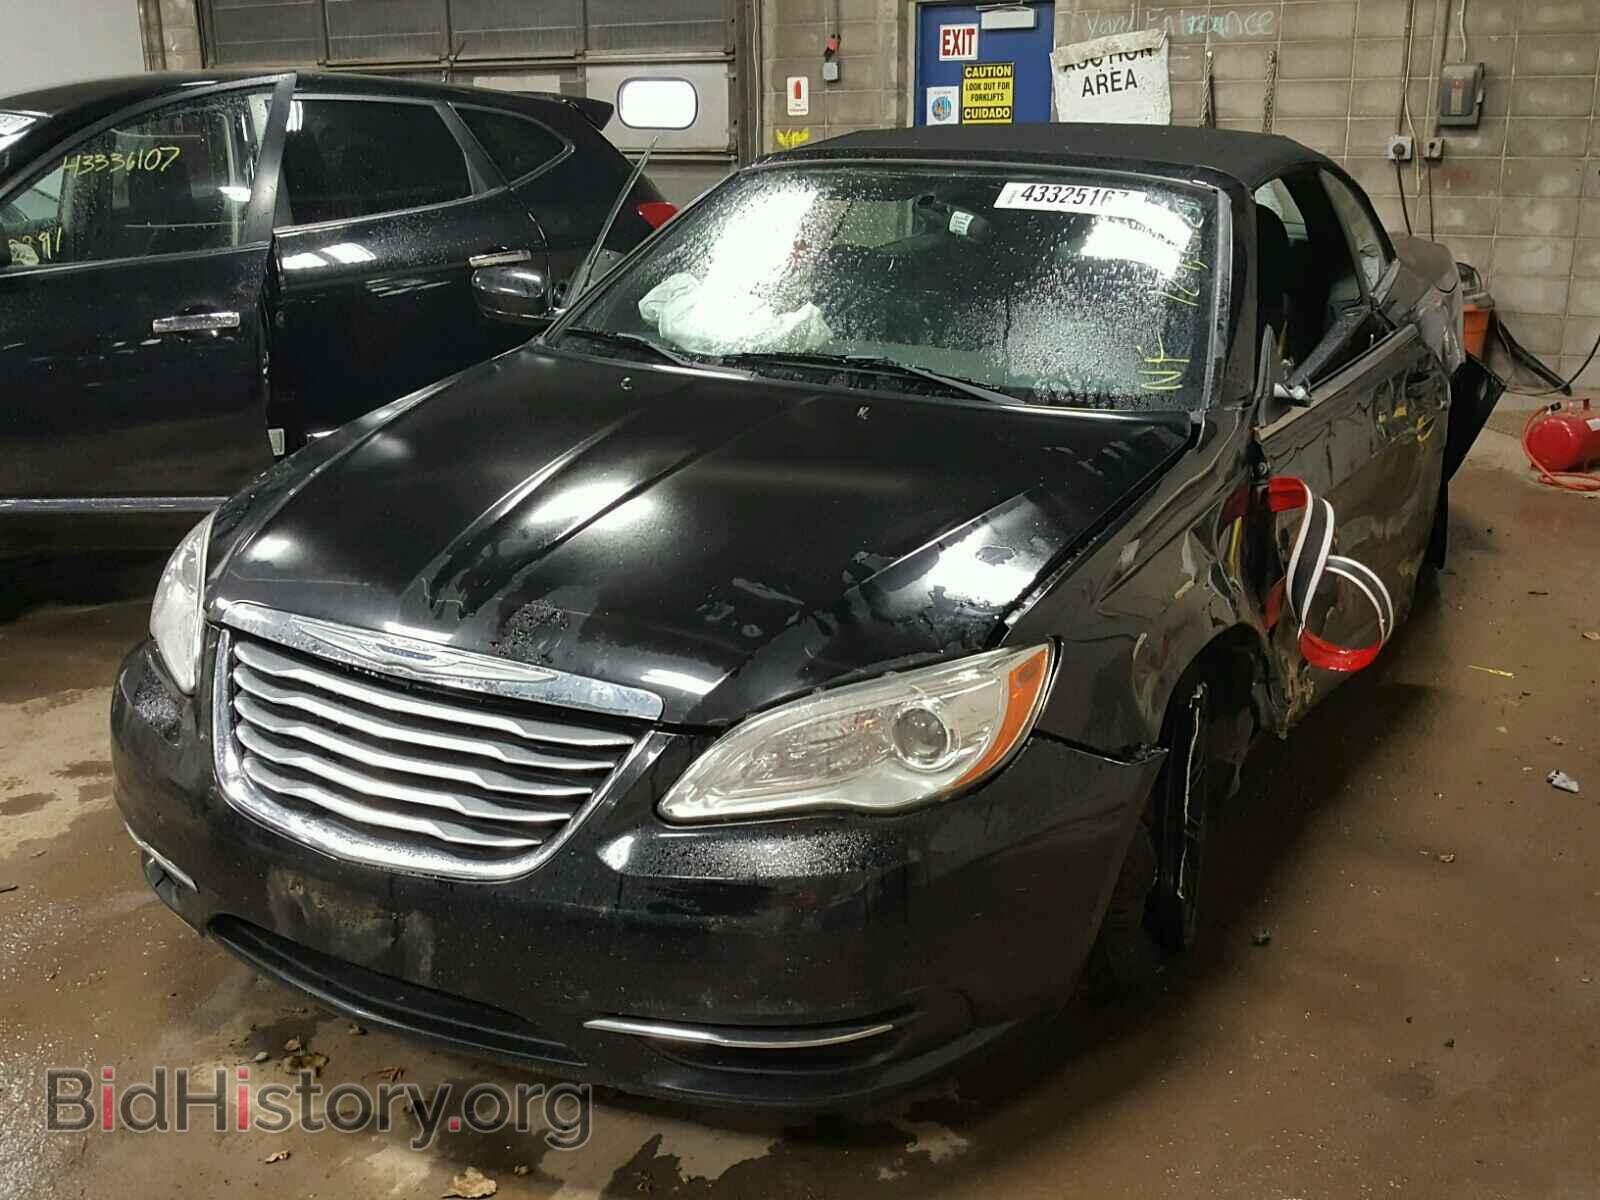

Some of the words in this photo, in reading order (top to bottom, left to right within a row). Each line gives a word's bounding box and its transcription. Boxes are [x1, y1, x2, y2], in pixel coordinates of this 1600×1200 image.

[941, 27, 976, 58] EXIT
[965, 65, 1012, 78] CAUTION
[965, 82, 982, 91] LOOK
[983, 81, 996, 91] OUT
[997, 81, 1011, 90] FOR
[1081, 68, 1138, 98] AREA
[970, 92, 1005, 102] FORKLIFTS
[964, 107, 1010, 119] CUIDADO
